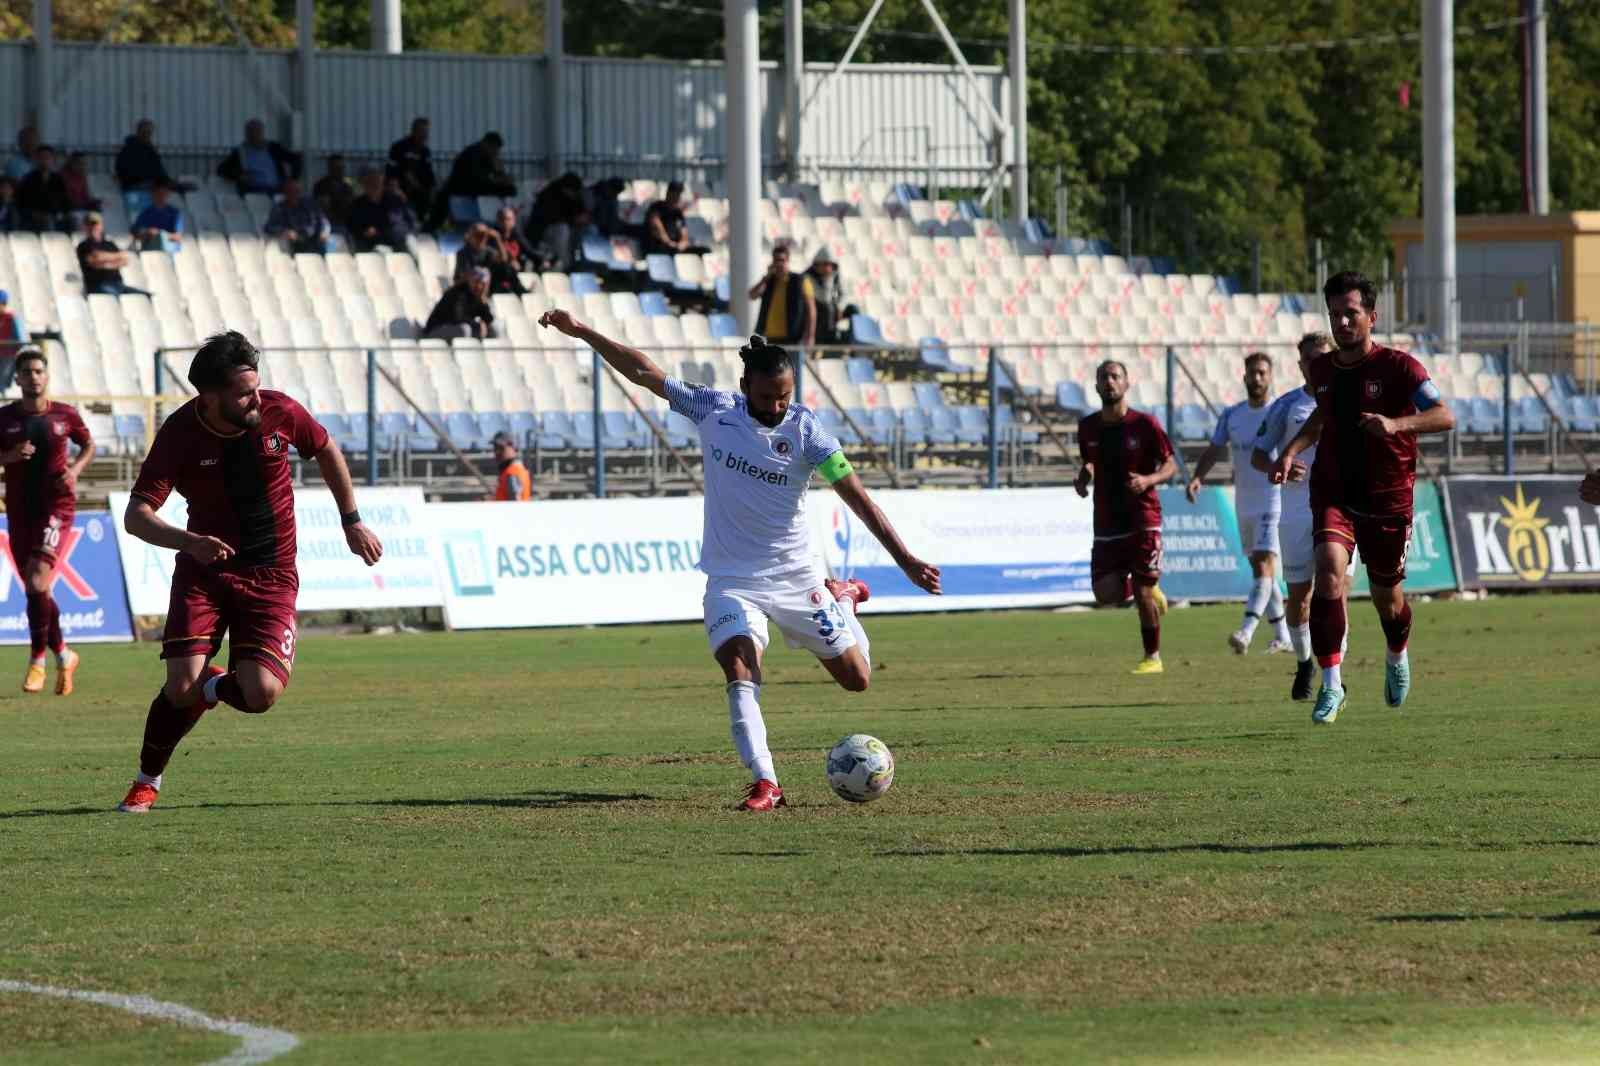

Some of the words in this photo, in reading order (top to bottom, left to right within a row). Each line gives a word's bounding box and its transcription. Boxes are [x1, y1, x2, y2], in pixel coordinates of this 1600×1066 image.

[725, 451, 788, 486] bitexen
[43, 527, 60, 547] 10
[497, 543, 568, 578] ASSA
[281, 628, 295, 657] 3
